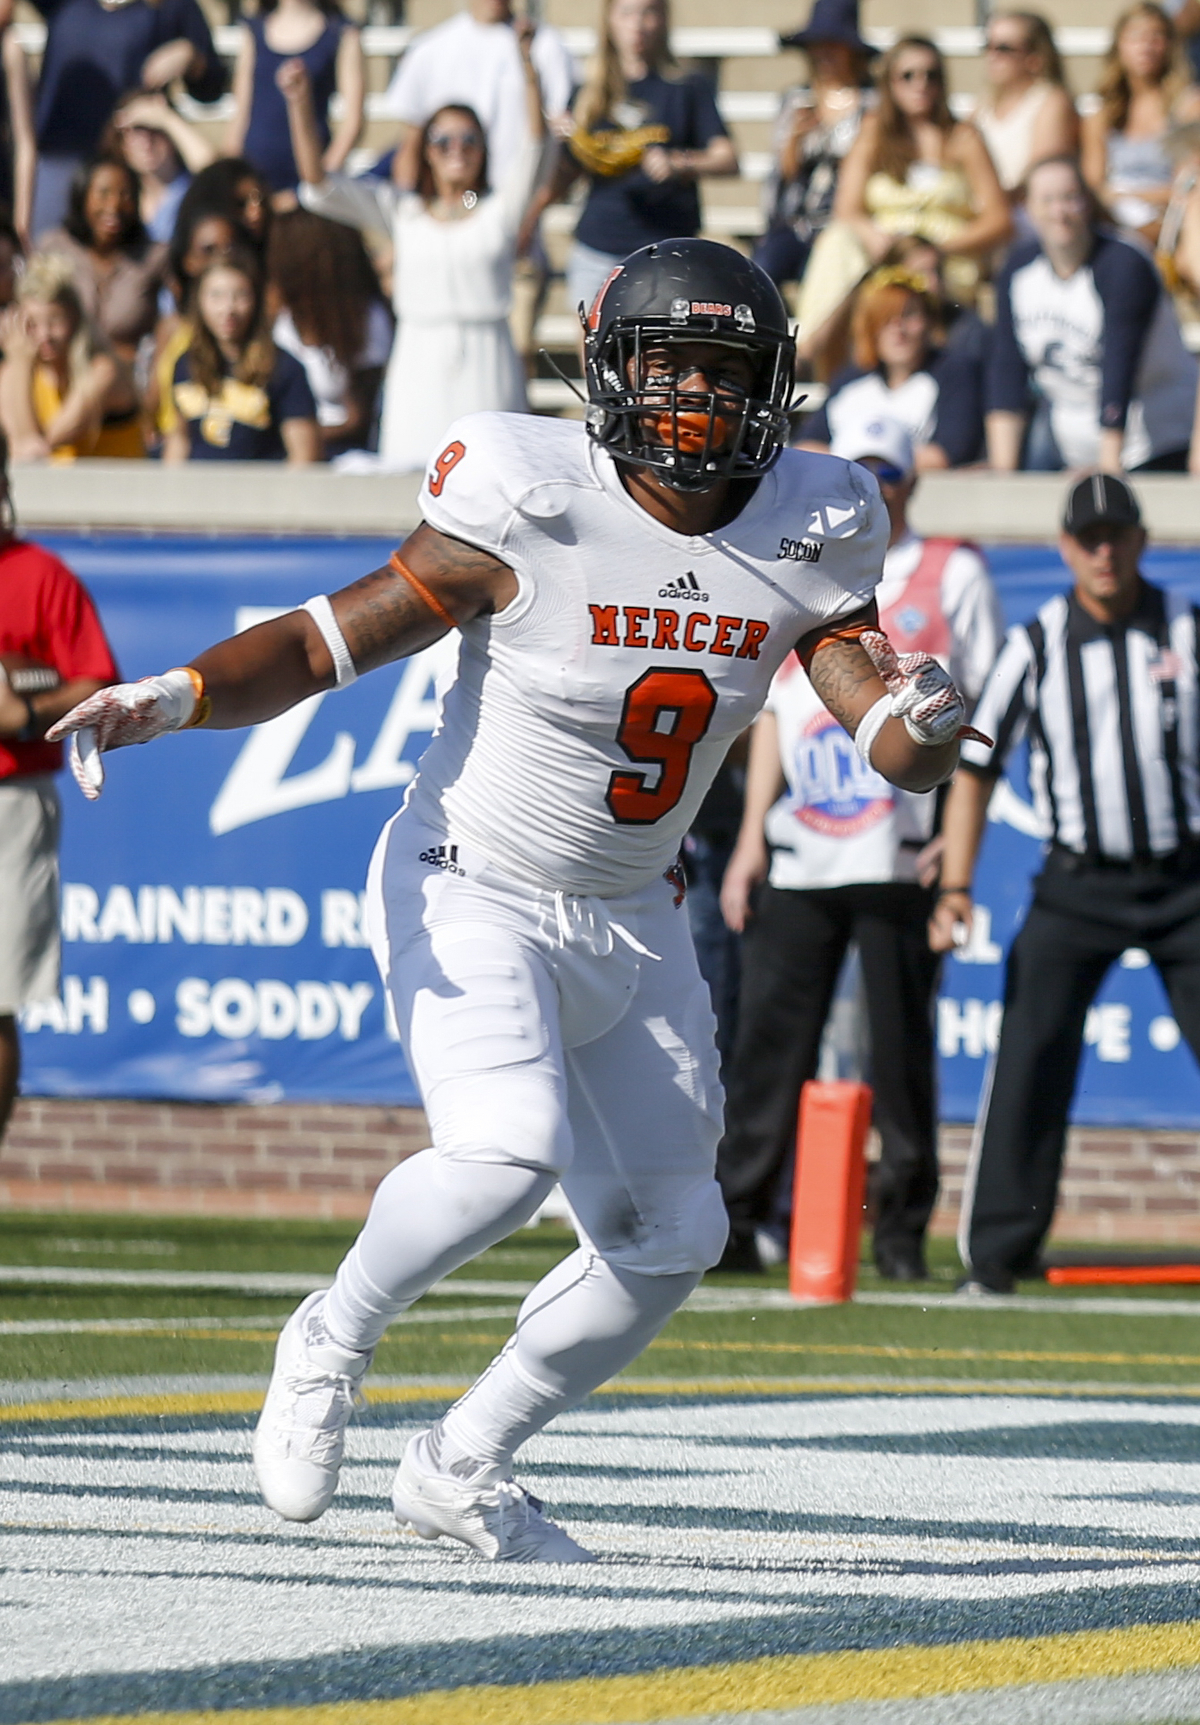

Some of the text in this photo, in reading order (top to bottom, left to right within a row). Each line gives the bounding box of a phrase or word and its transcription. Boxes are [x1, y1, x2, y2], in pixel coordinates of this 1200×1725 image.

[691, 302, 732, 317] BEARS
[429, 440, 466, 497] 9
[777, 537, 824, 563] SOCON
[658, 587, 710, 603] adidas
[588, 604, 769, 661] MERCER
[604, 666, 718, 826] 9
[419, 852, 466, 877] adidas
[61, 883, 308, 947] RAINERD
[176, 977, 374, 1041] SODDY
